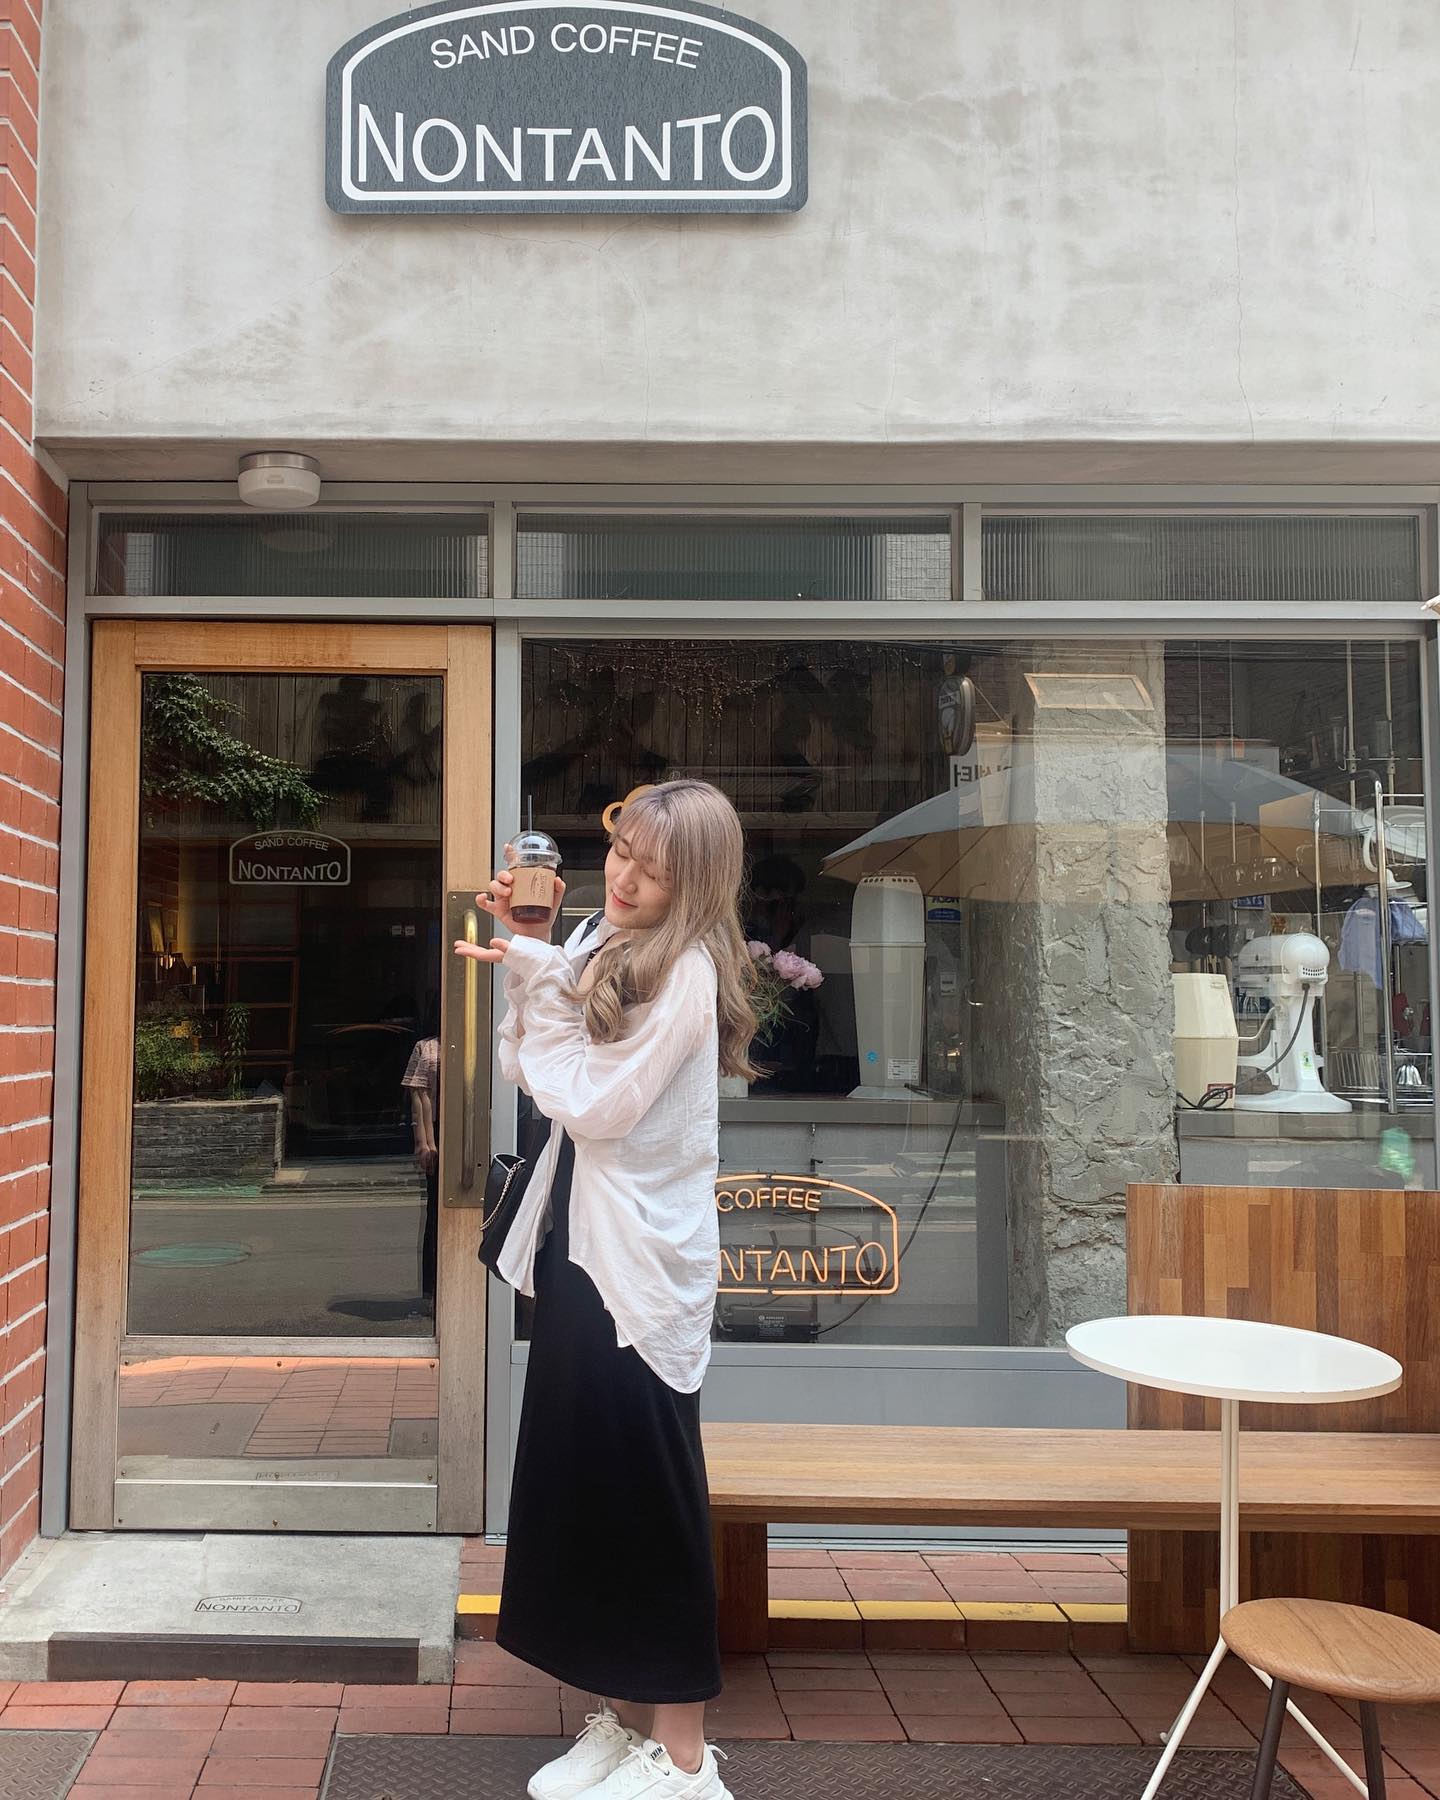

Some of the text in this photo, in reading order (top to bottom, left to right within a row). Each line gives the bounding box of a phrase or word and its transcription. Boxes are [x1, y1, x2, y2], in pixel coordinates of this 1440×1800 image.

[430, 23, 703, 70] SAND COFFEE
[357, 103, 776, 183] NONTANTO
[254, 837, 331, 851] SAND COFFEE
[238, 859, 341, 880] NONTANTO
[716, 1187, 823, 1212] COFFEE
[717, 1241, 888, 1286] NTANTO
[198, 1602, 299, 1612] NONTANTO
